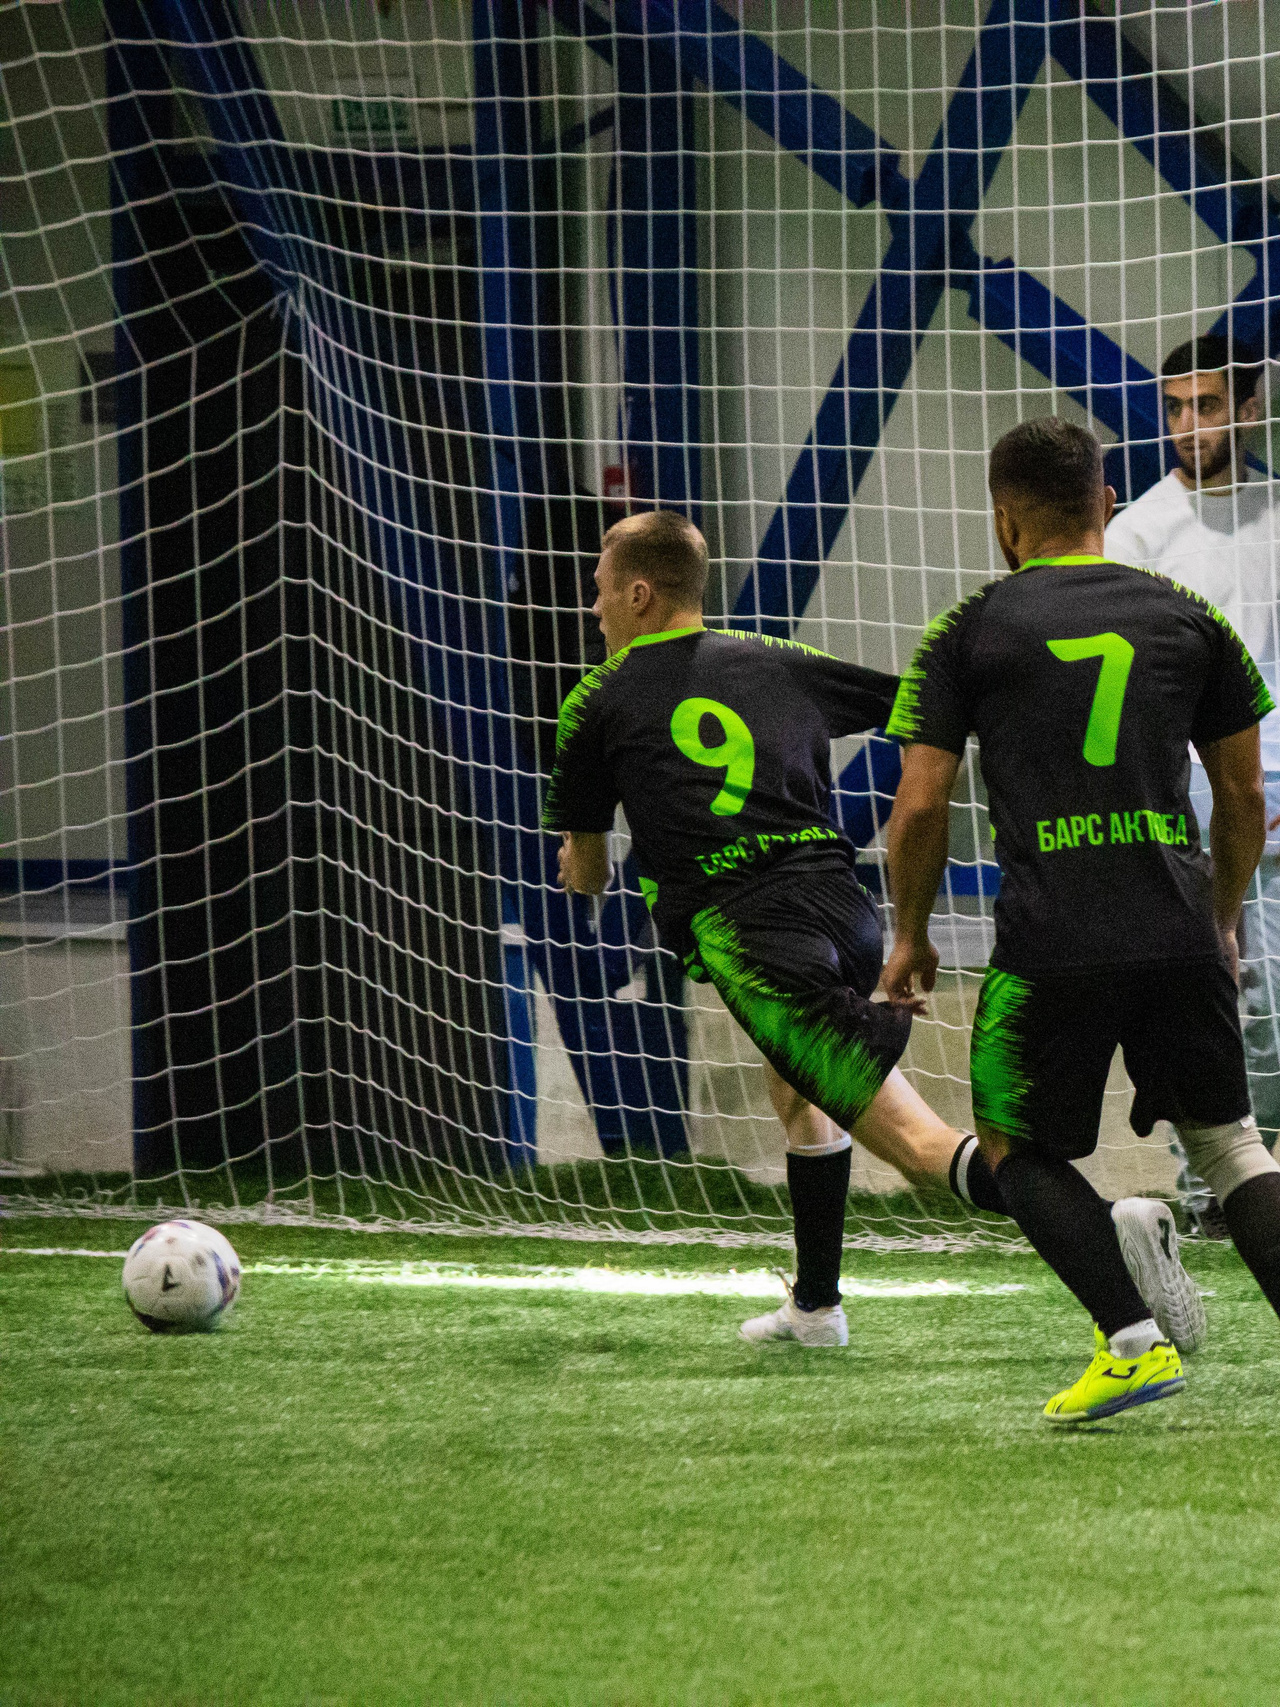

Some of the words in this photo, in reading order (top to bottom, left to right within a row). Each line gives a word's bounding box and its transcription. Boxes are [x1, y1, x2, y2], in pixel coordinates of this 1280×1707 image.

[670, 696, 756, 816] 9
[1045, 631, 1136, 767] 7
[1036, 812, 1105, 853] БАРС
